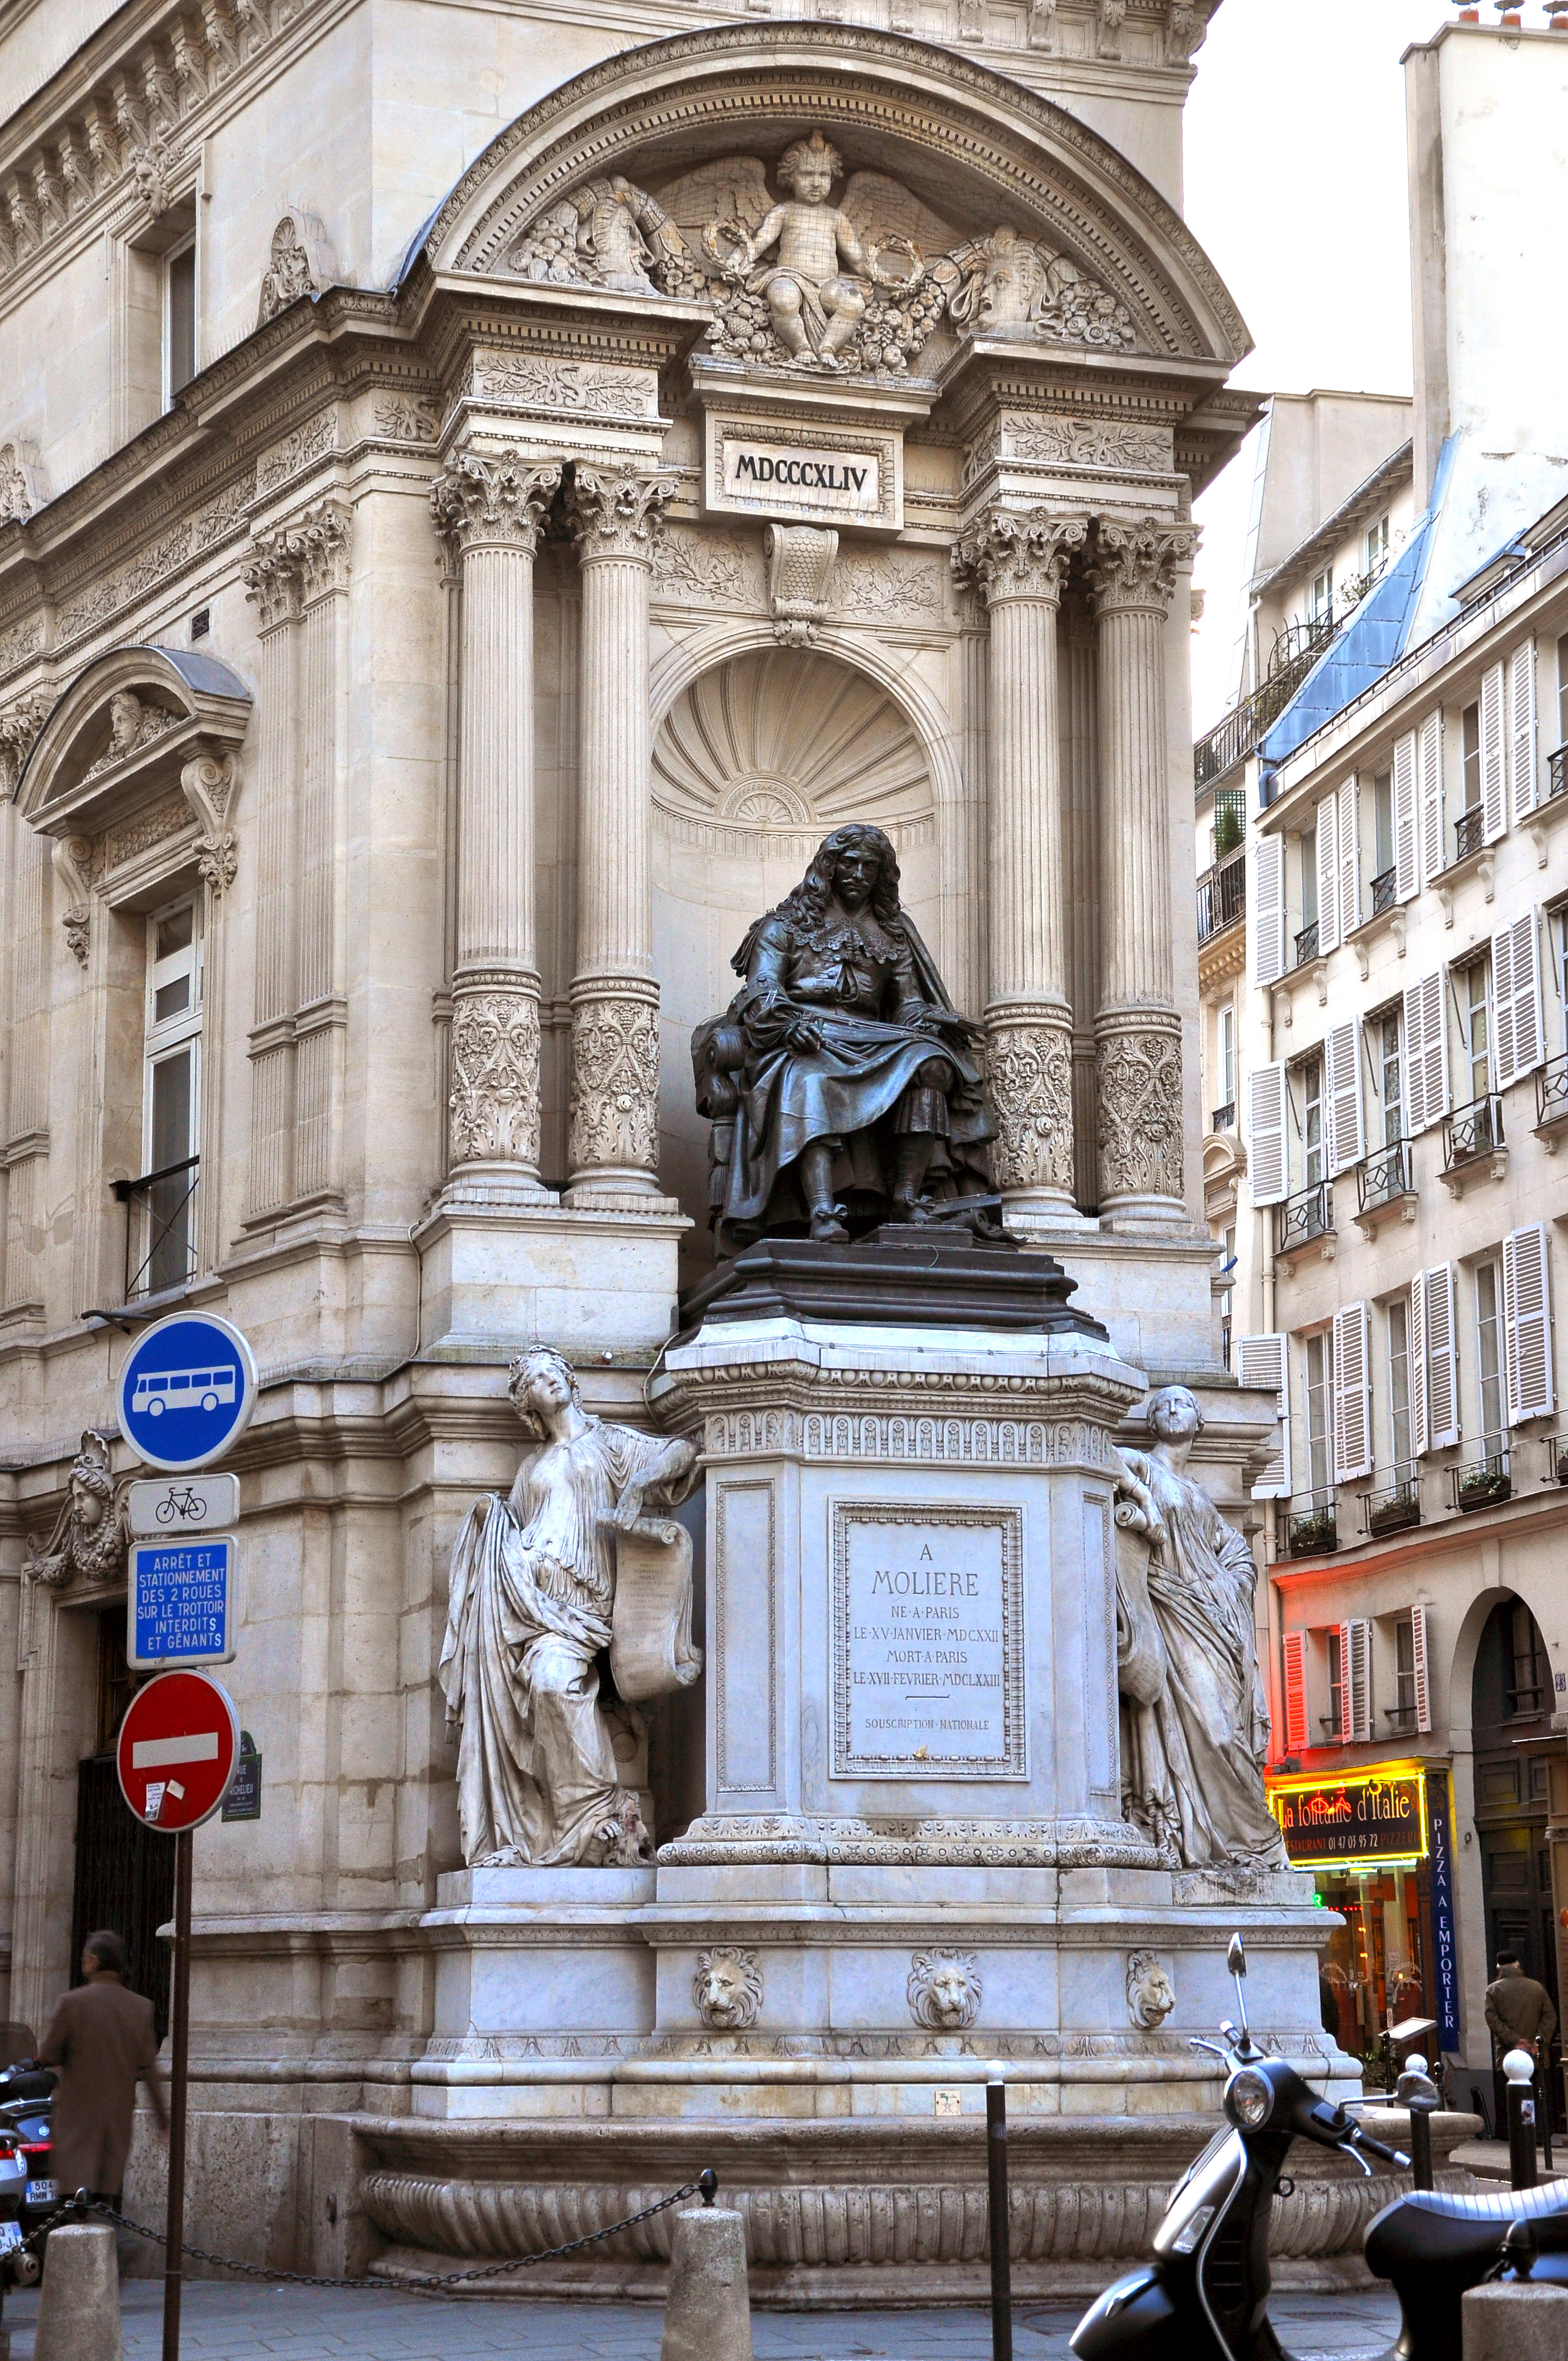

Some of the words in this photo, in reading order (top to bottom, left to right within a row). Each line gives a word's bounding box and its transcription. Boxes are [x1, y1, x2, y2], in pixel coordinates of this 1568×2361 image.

[735, 455, 868, 491] MDCCCXLIV
[154, 1553, 192, 1570] ARRÊT
[198, 1553, 211, 1567] ET
[919, 1543, 933, 1561] A
[139, 1568, 225, 1587] STATIONNEMENT
[872, 1571, 979, 1596] MOLIERE
[142, 1590, 165, 1603] DES
[171, 1588, 178, 1601] 2
[182, 1584, 221, 1600] ROUES
[138, 1604, 157, 1619] SUR
[162, 1604, 173, 1618] LE
[178, 1600, 224, 1617] TROTTOIR
[155, 1617, 216, 1634] INTERDITS
[148, 1637, 161, 1651] ET
[167, 1633, 221, 1649] GÊNANTS
[940, 1720, 989, 1730] NATIONALE
[1281, 1798, 1294, 1829] La
[1357, 1784, 1410, 1821] d'Italie
[1286, 1838, 1326, 1853] ESTAURANT
[1328, 1837, 1336, 1850] 01
[1338, 1836, 1346, 1849] 47
[1348, 1835, 1356, 1849] 03
[1359, 1834, 1366, 1848] 95
[1370, 1834, 1378, 1847] 72
[1434, 1819, 1446, 1886] PIZZA
[1438, 1895, 1447, 1907] A
[1439, 1916, 1454, 2028] EMPORTER
